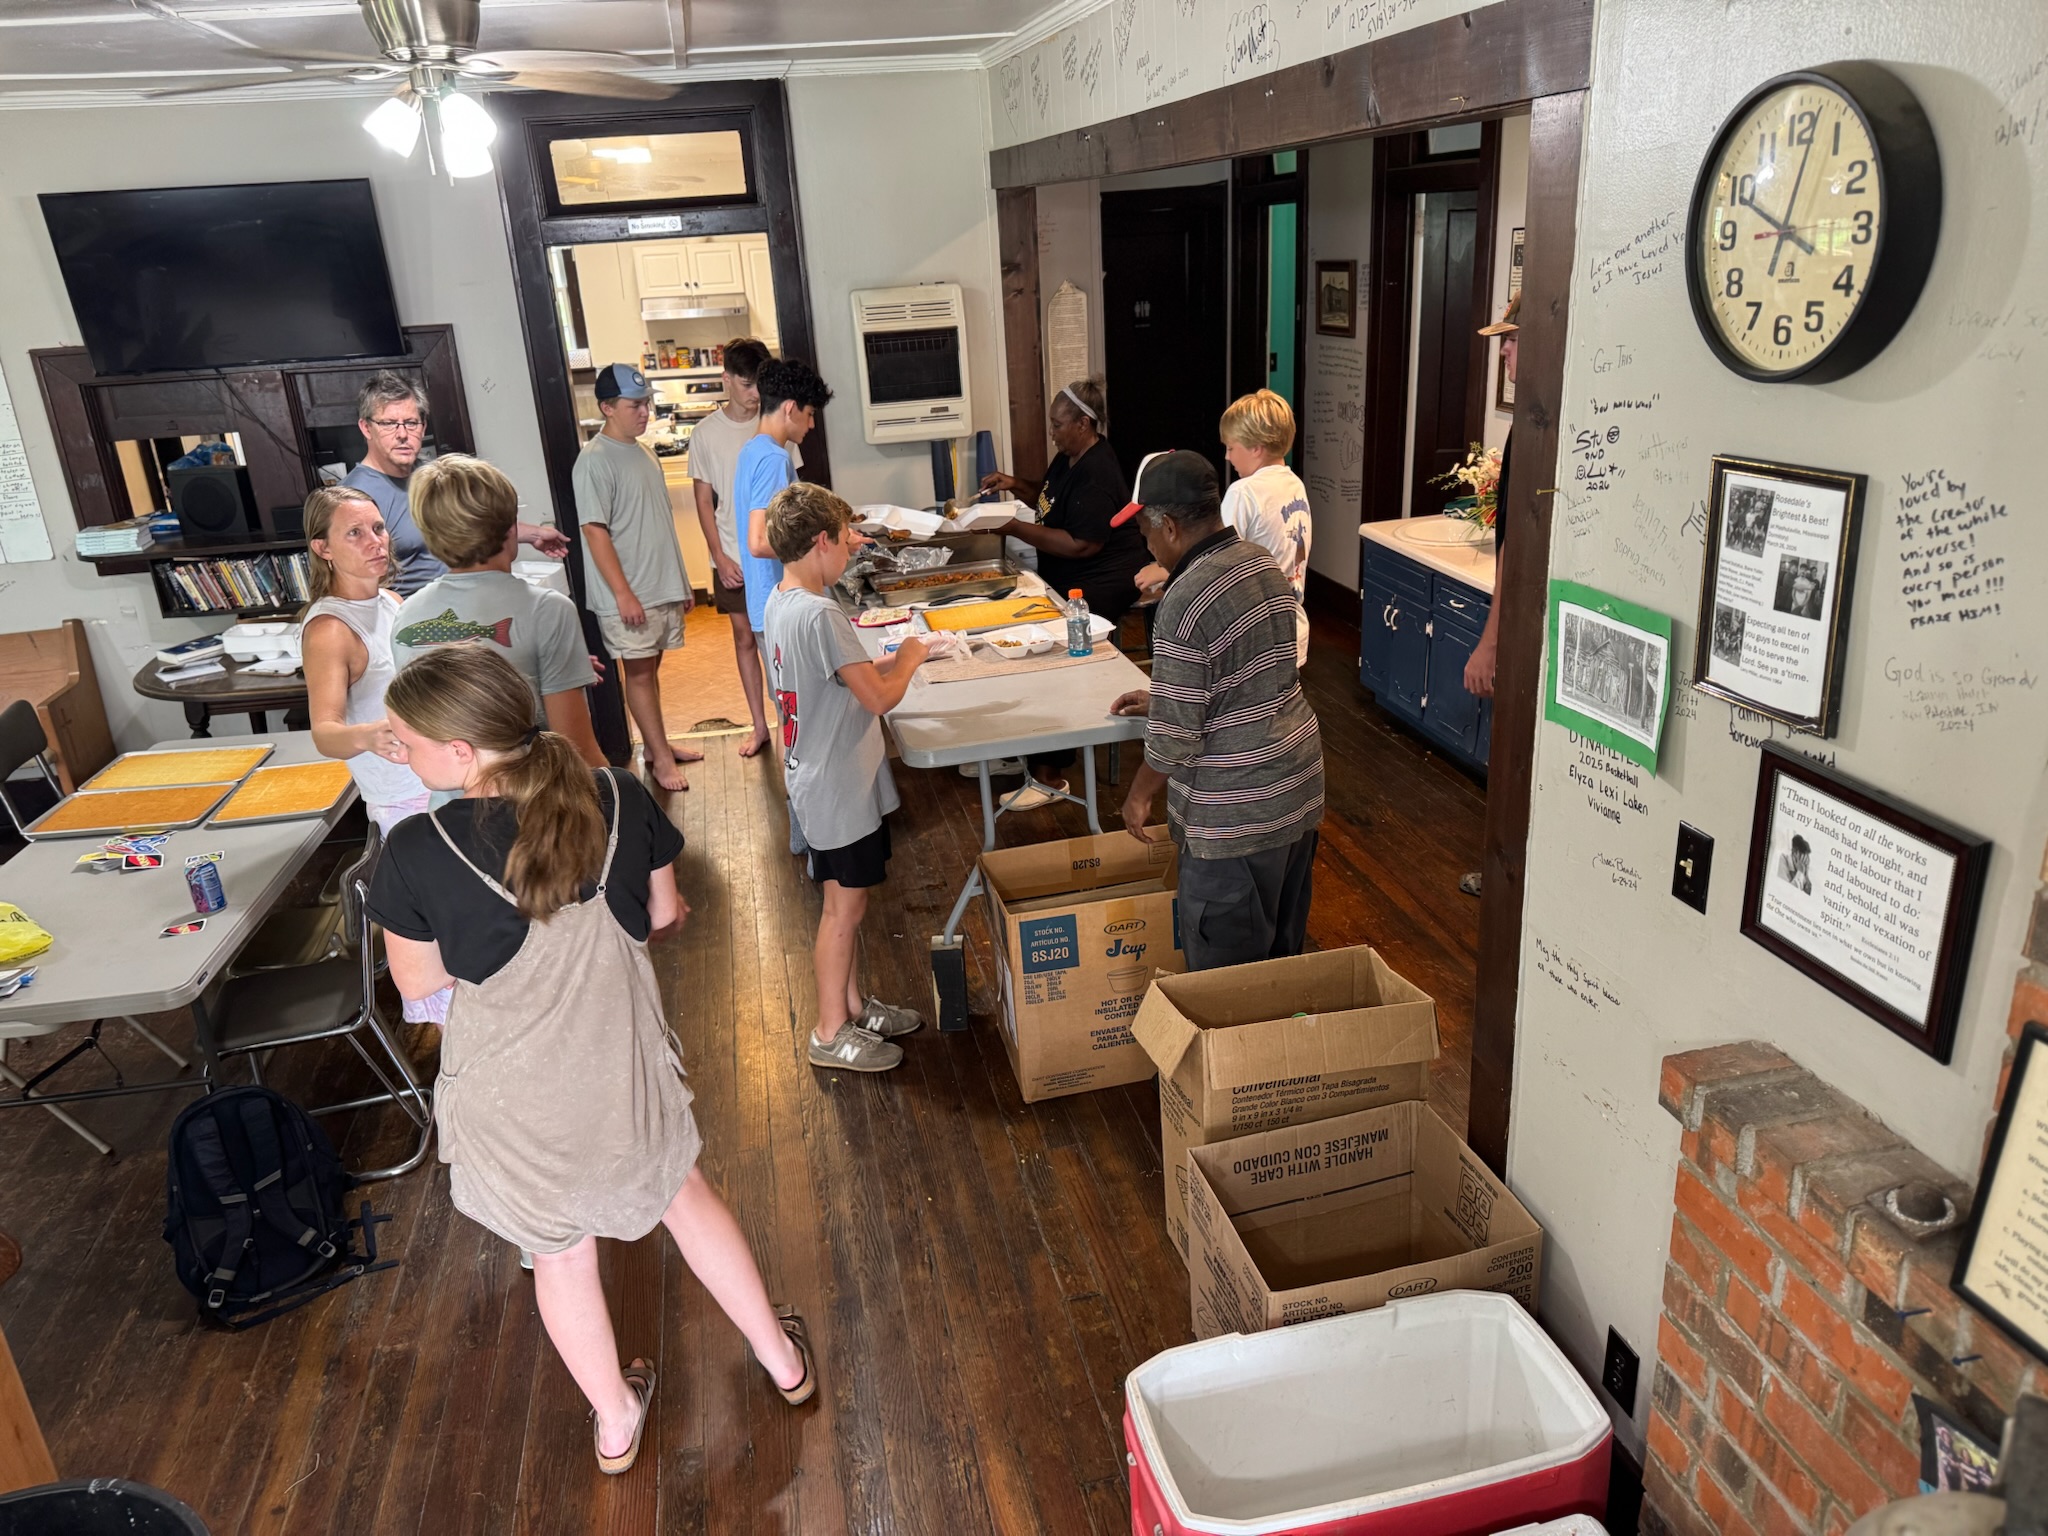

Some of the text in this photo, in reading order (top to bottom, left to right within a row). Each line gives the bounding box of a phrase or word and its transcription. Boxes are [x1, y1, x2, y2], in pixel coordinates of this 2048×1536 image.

[1788, 111, 1815, 146] 12
[1758, 132, 1776, 165] 11
[1730, 174, 1756, 206] 10
[1845, 160, 1868, 195] 2
[1614, 243, 1631, 259] one
[1634, 212, 1675, 245] another
[1719, 220, 1737, 251] 9
[1852, 210, 1873, 244] 3
[1605, 270, 1613, 284] I
[1617, 262, 1638, 275] have
[1632, 263, 1663, 285] Jesus
[1726, 268, 1743, 298] 8
[1832, 265, 1854, 297] 4
[1745, 301, 1762, 331] 7
[1804, 301, 1824, 333] 5
[1773, 315, 1792, 345] 6
[1899, 480, 1966, 510] loved by
[1772, 507, 1801, 521] Brightest
[1809, 515, 1829, 527] Best!
[1896, 514, 1923, 528] the
[1926, 525, 1952, 539] the
[1958, 504, 2008, 531] whole
[1902, 557, 2005, 595] every person
[1903, 554, 1975, 579] And so is
[1746, 615, 1811, 640] Expecting all ten of
[1744, 630, 1810, 654] you guys to excel in
[1741, 656, 1756, 667] Lord.
[1757, 661, 1769, 671] See
[1770, 667, 1778, 675] ya
[1758, 647, 1799, 666] to serve the
[1884, 656, 1924, 688] God
[1579, 751, 1639, 788] 2025 Basketball
[1569, 765, 1594, 789] Elyza
[1599, 781, 1618, 801] Lexi
[1587, 795, 1621, 824] Vivianne
[1779, 802, 1928, 885] that my hands had wrought, and
[1817, 803, 1848, 826] looked
[1849, 821, 1862, 834] on
[1863, 827, 1877, 840] all
[1877, 834, 1894, 850] the
[1895, 844, 1928, 867] works
[1072, 857, 1100, 870] 8SJ20
[1831, 847, 1842, 860] on
[1844, 853, 1858, 868] the
[1859, 858, 1892, 886] labour
[1894, 881, 1915, 898] that
[1827, 861, 1921, 919] had laboured to do:
[1824, 879, 1920, 938] and, behold, all was
[1034, 926, 1065, 937] STOCK NO.
[1109, 920, 1141, 932] DART
[1823, 895, 1932, 961] vanity and vexation of
[1059, 936, 1070, 945] NO.
[1031, 947, 1069, 963] 8SJ20
[1094, 1002, 1138, 1016] INSULATED
[1101, 996, 1132, 1008] HOT OR
[866, 1016, 884, 1031] N
[1090, 1025, 1127, 1037] ENVASES
[1092, 1038, 1136, 1050] CALIENTES
[1096, 1033, 1118, 1043] PARA
[837, 1044, 861, 1062] N
[1232, 1076, 1377, 1105] Contenedor Térmico con Tapa Bisagrada
[1232, 1102, 1258, 1114] Grande
[1260, 1099, 1279, 1110] Color
[1280, 1095, 1305, 1106] Blanco
[1307, 1093, 1321, 1101] con
[1328, 1083, 1390, 1099] Compartimientos
[1232, 1117, 1280, 1131] 1/150 150
[1234, 1151, 1290, 1174] CUIDADO
[1295, 1144, 1321, 1160] CON
[1251, 1147, 1373, 1185] HANDLE WITH CARE
[1487, 1255, 1533, 1273] CONTENIDO
[1491, 1247, 1534, 1265] CONTENTS
[1508, 1262, 1532, 1278] 200
[1394, 1280, 1432, 1295] DART
[1283, 1297, 1330, 1310] STOCK NO.
[1330, 1302, 1345, 1310] NO.
